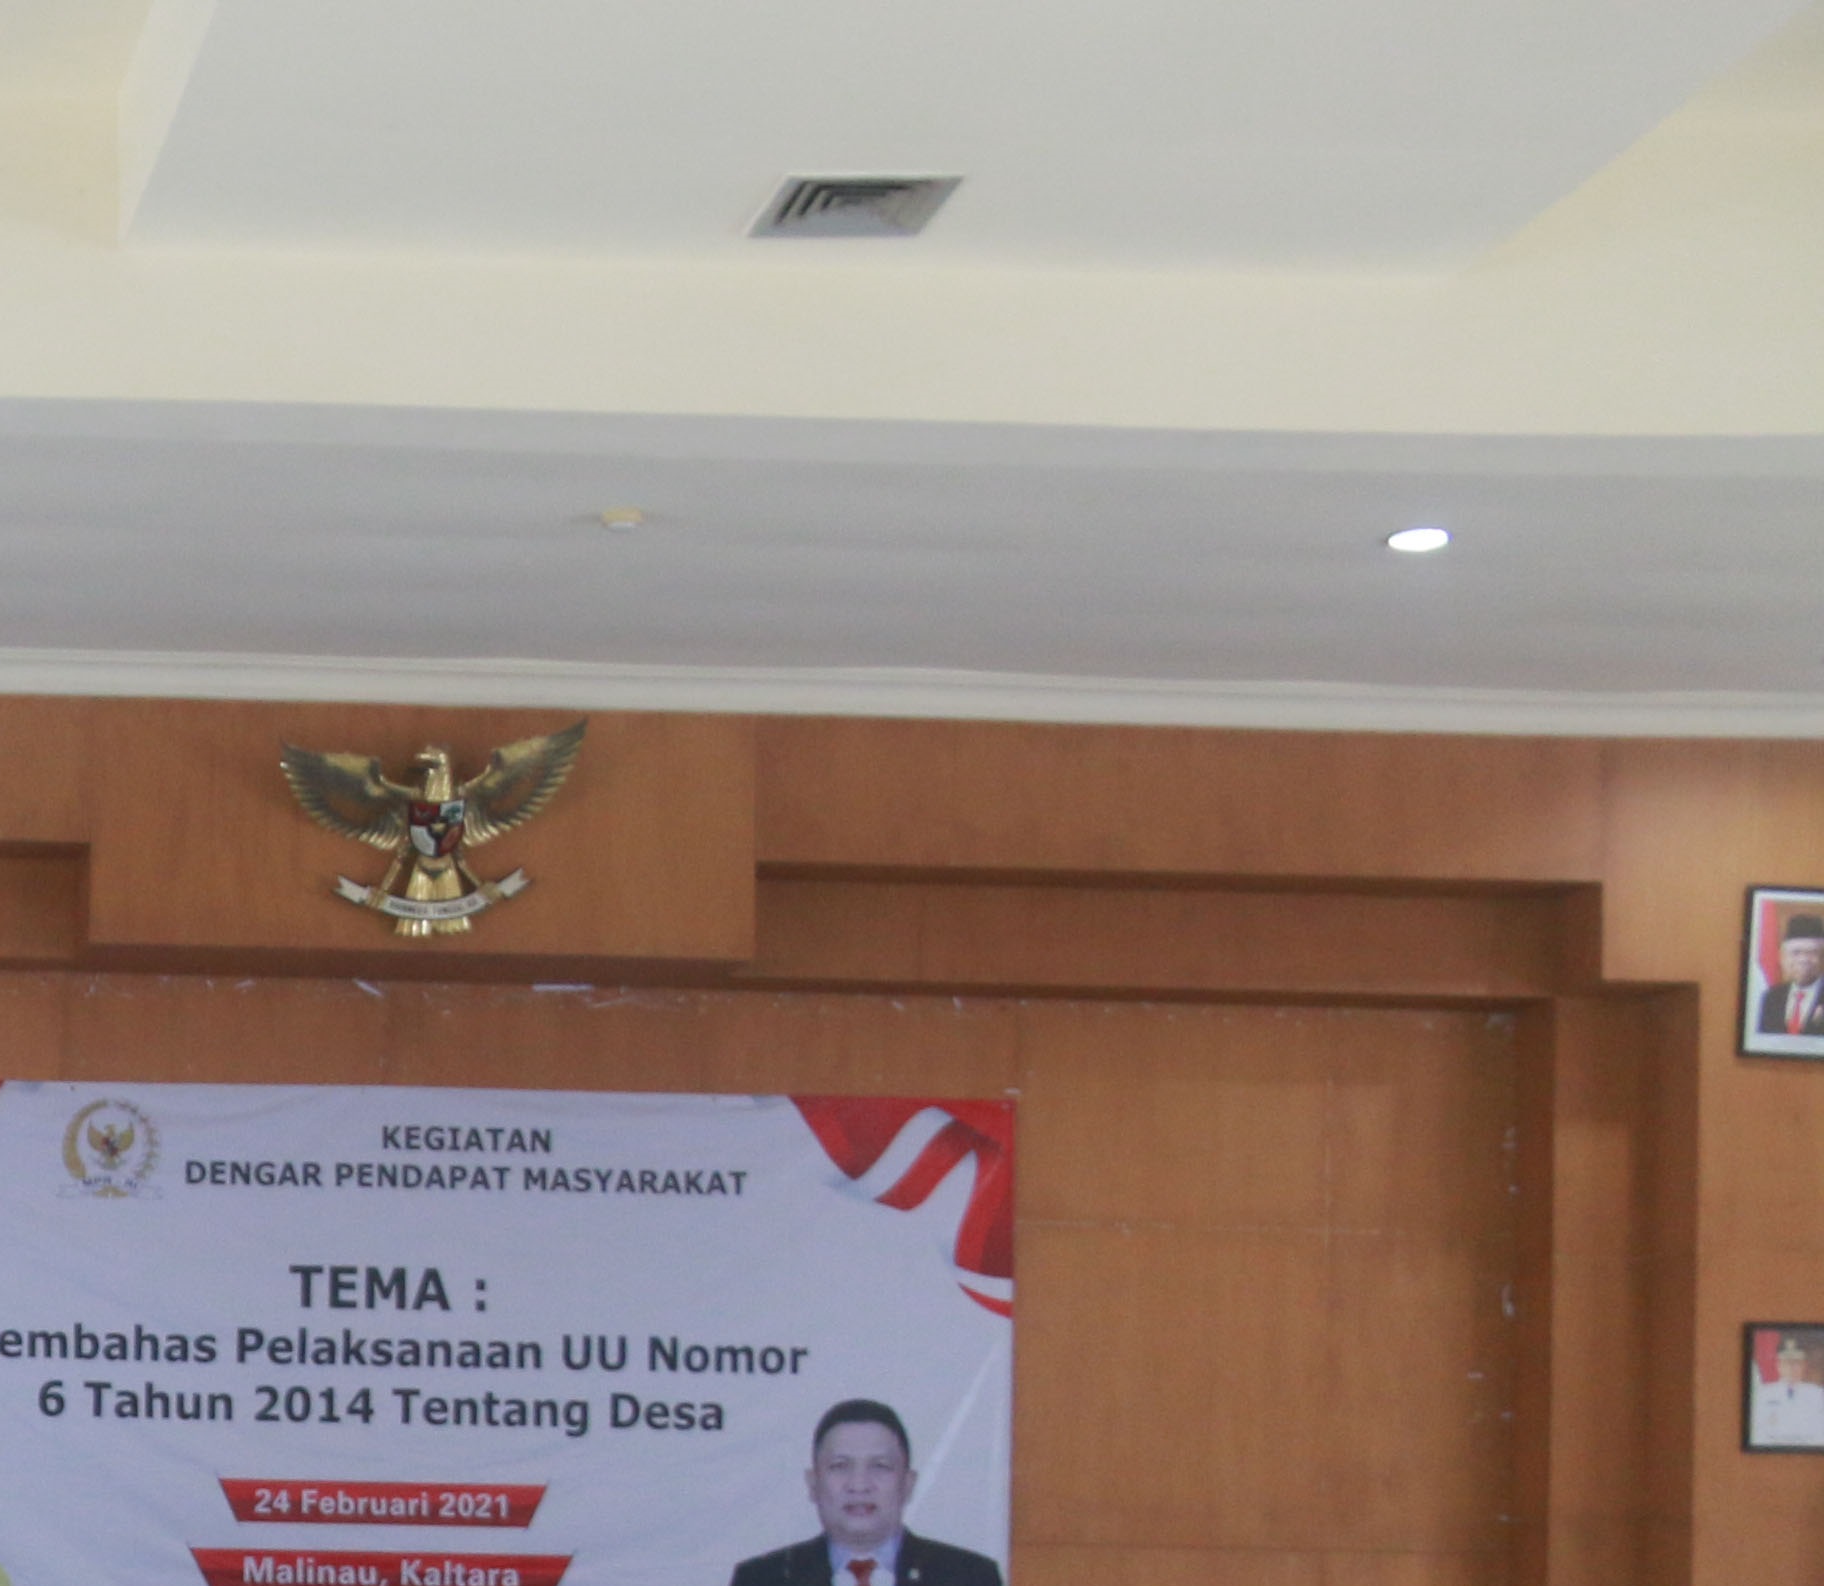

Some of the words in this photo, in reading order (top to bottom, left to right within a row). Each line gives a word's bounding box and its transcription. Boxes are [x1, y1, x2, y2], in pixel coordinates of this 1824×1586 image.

[382, 1125, 551, 1153] KEGIATAN
[185, 1160, 322, 1187] DENGAR
[335, 1162, 511, 1190] PENDAPAT
[523, 1167, 747, 1195] MASYARAKAT
[289, 1265, 451, 1311] TEMA
[237, 1327, 542, 1370] Pelaksanaan
[562, 1335, 627, 1372] UU
[648, 1336, 808, 1375] Nomor
[38, 1380, 66, 1417] 6
[84, 1381, 233, 1421] Tahun
[255, 1385, 375, 1424] 2014
[392, 1388, 589, 1435] Tentang
[610, 1393, 724, 1431] Desa
[254, 1488, 291, 1514] 24
[301, 1489, 429, 1516] Februari
[439, 1492, 508, 1518] 2021
